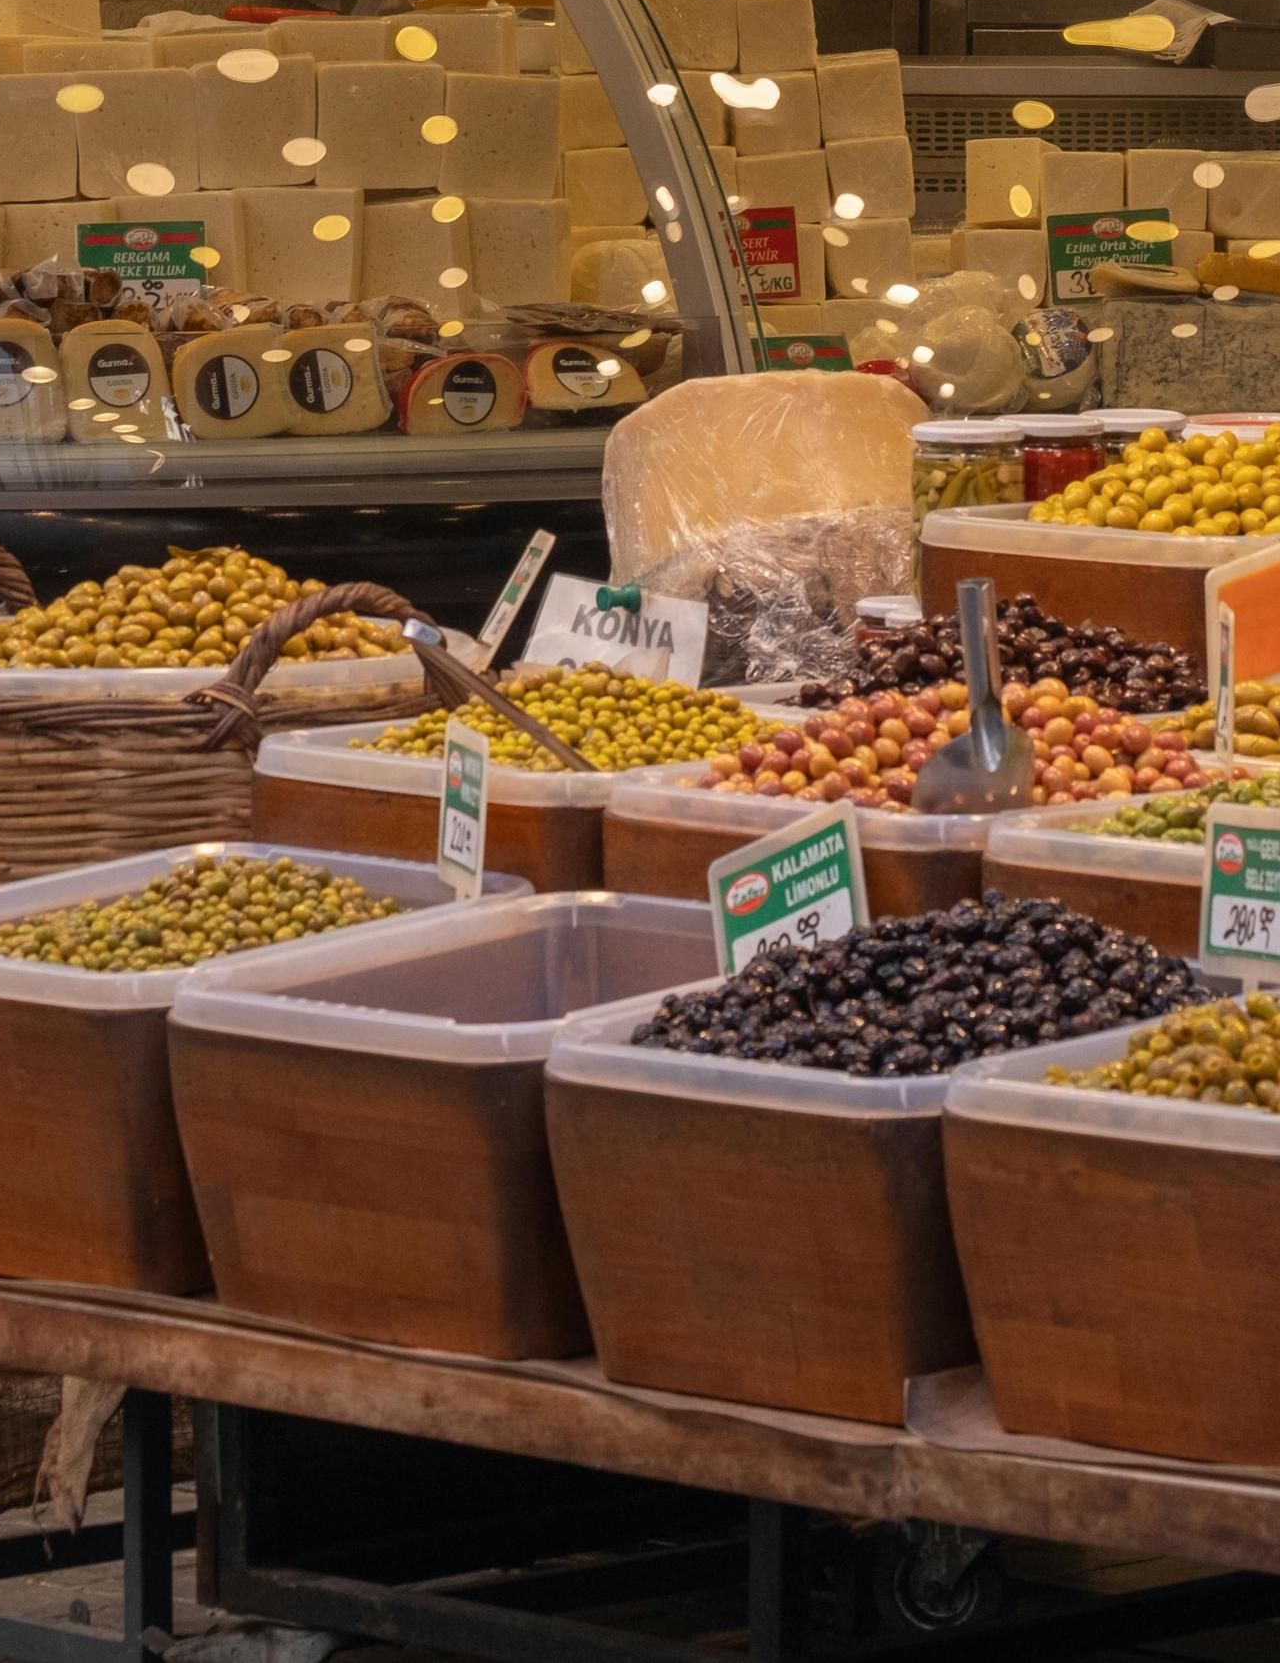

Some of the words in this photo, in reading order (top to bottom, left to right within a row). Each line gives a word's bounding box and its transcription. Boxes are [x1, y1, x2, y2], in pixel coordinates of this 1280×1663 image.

[742, 237, 769, 249] SERT
[1065, 242, 1097, 254] Ezine
[1100, 239, 1127, 252] Orta
[113, 251, 171, 264] BERGAMA
[744, 249, 779, 261] EYNİR
[146, 264, 187, 277] TULUM
[571, 603, 675, 654] KONYA
[771, 832, 845, 884] KALAMATA
[784, 864, 840, 908] LİMONLU
